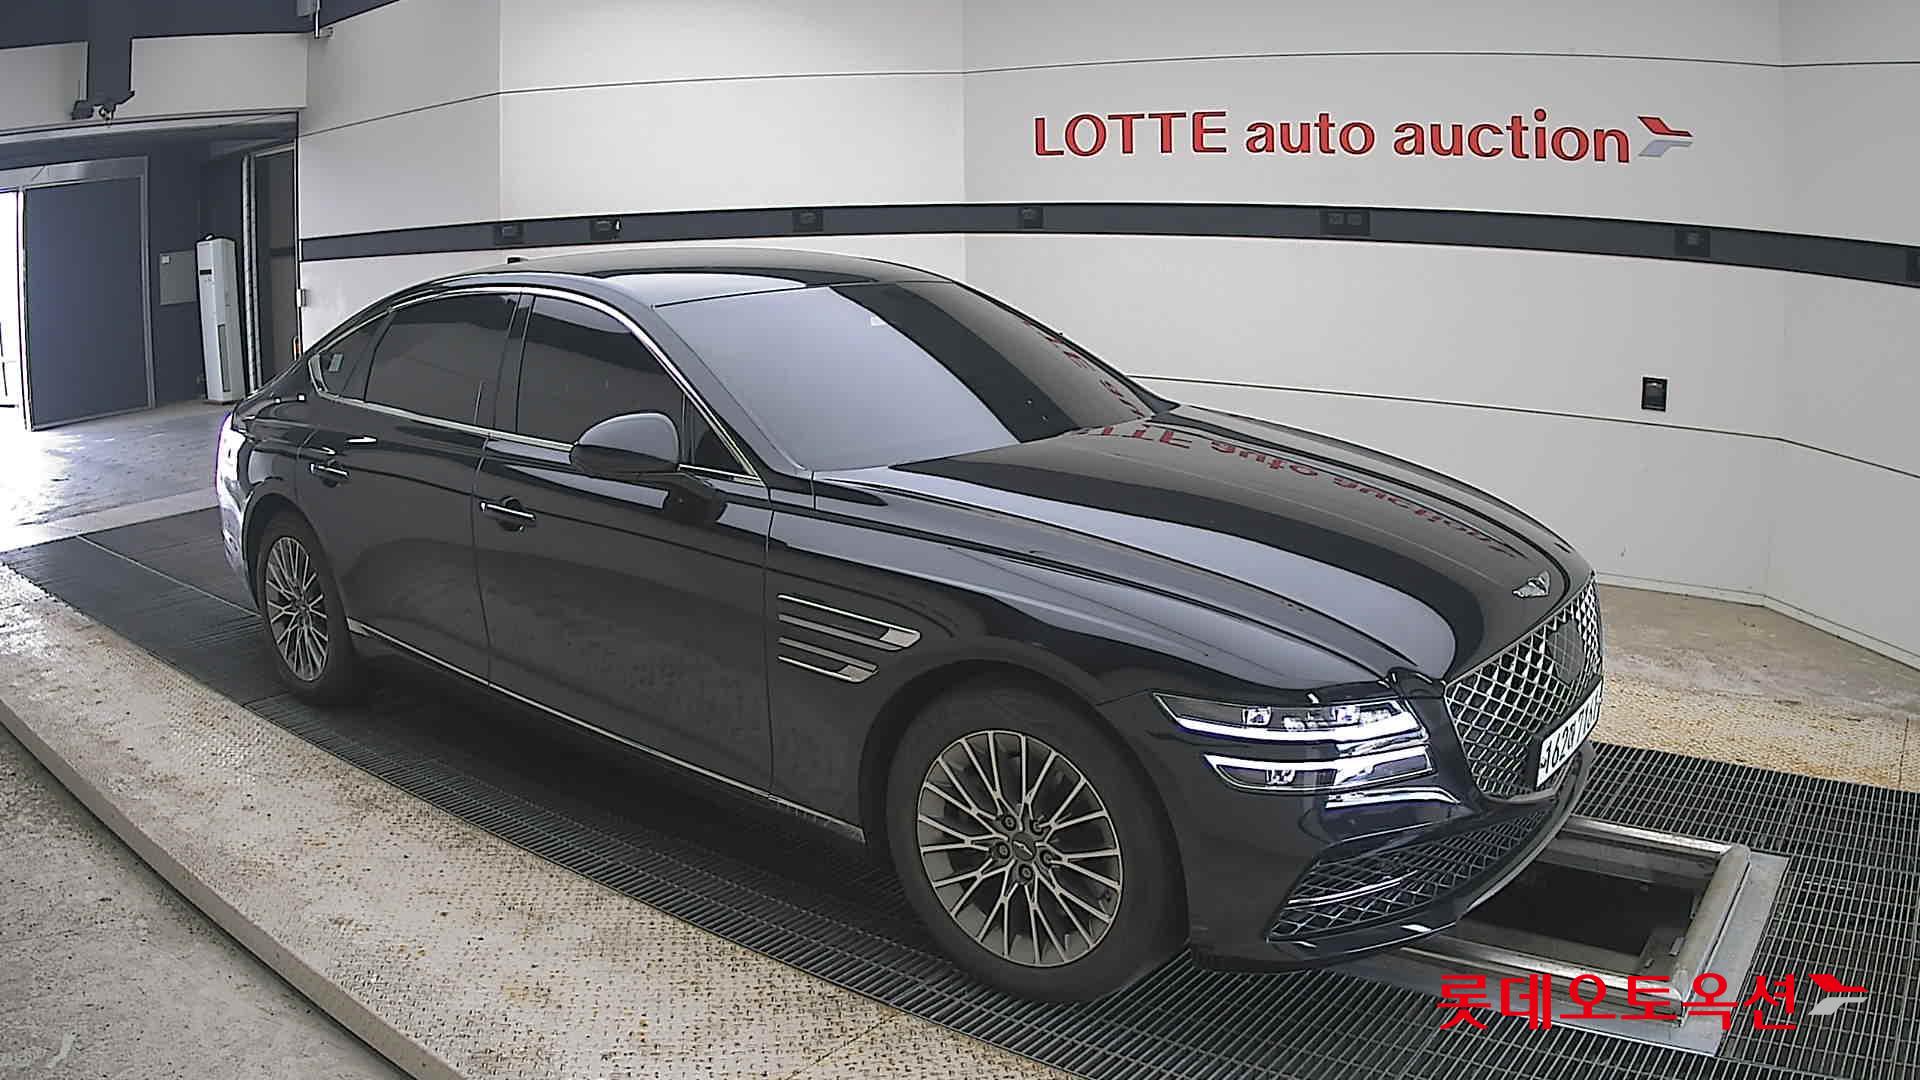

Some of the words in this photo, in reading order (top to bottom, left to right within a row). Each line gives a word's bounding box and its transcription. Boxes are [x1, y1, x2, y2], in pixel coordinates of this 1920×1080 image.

[1034, 110, 1227, 157] LOTTE
[1245, 112, 1376, 155] auto
[1393, 108, 1630, 163] auction
